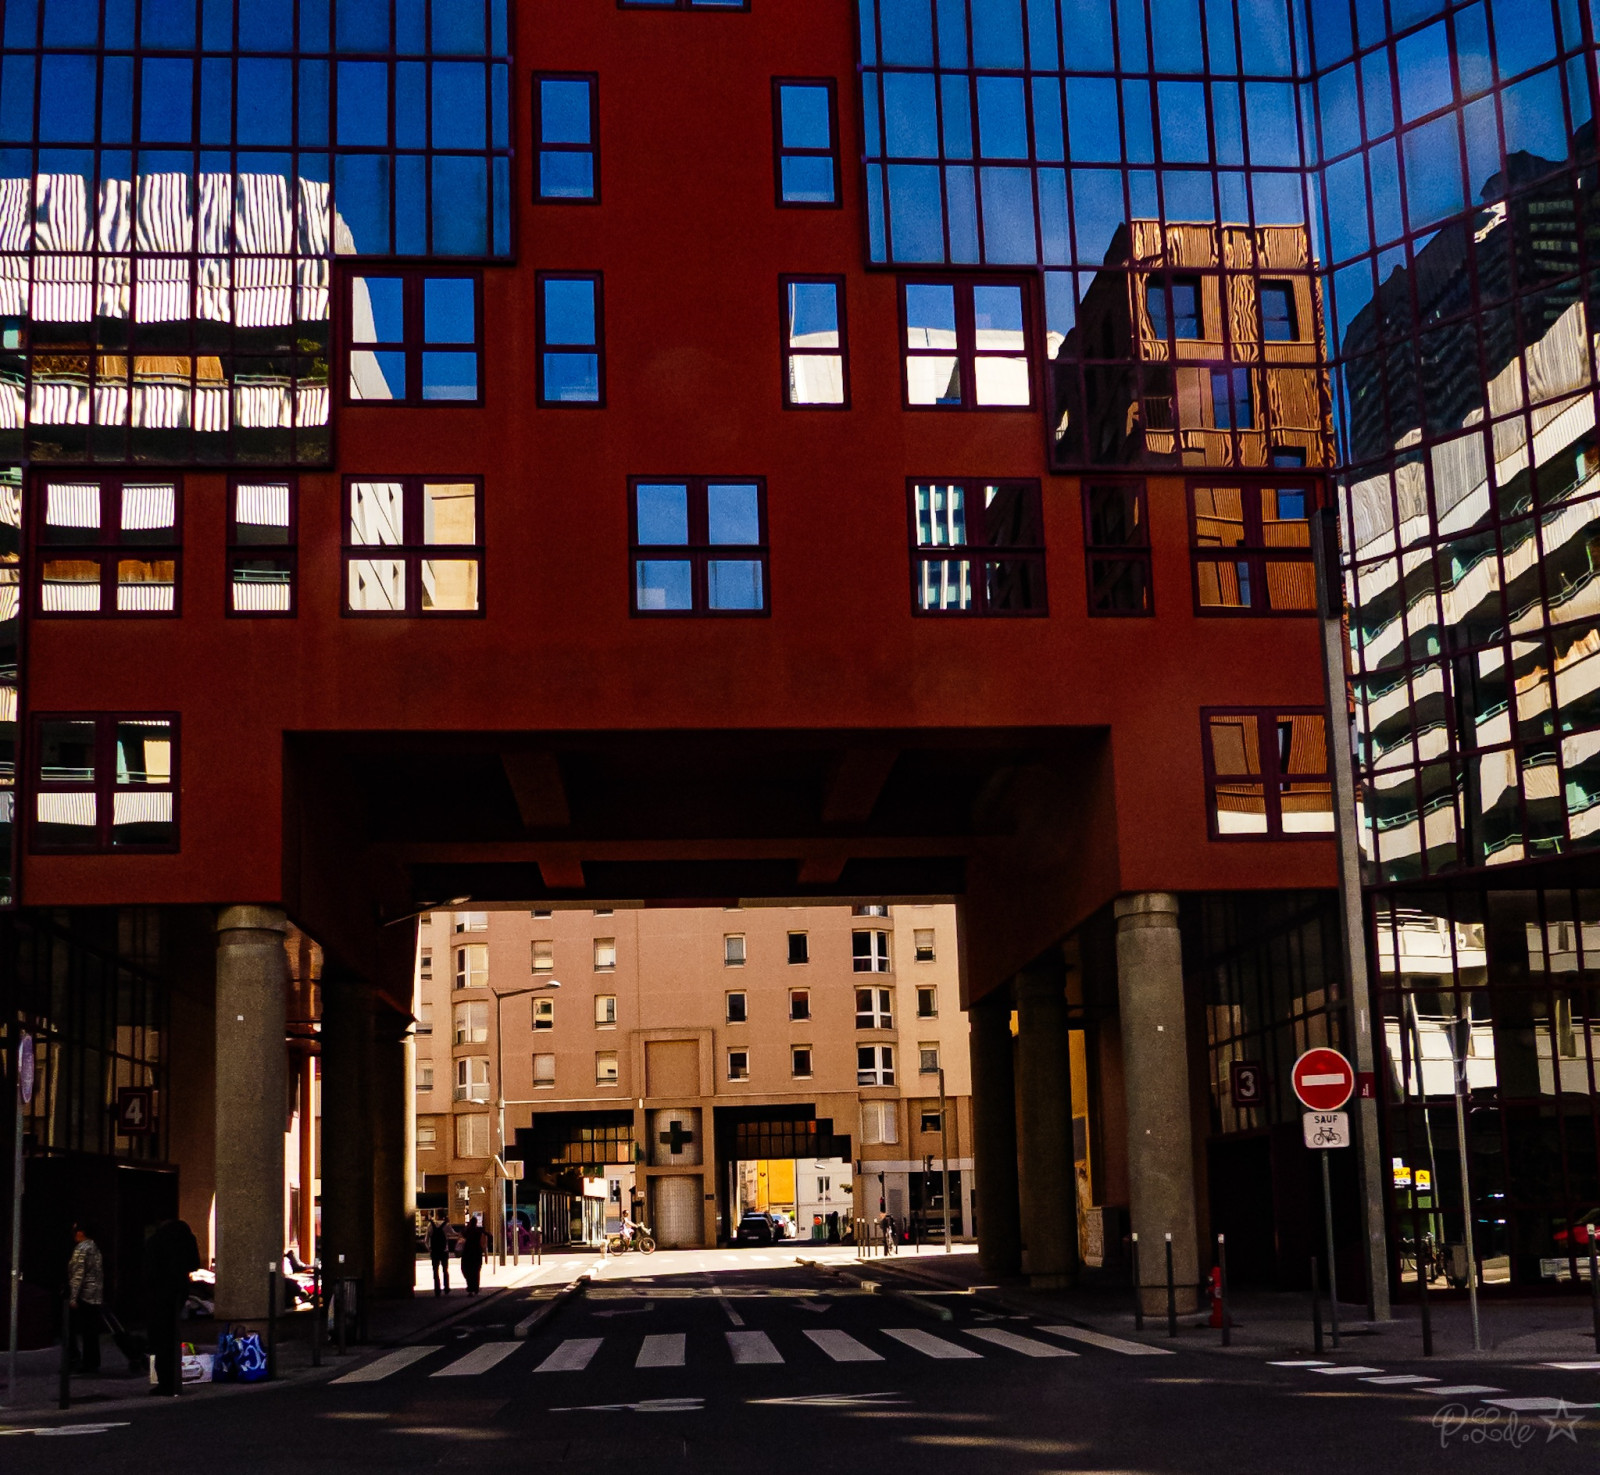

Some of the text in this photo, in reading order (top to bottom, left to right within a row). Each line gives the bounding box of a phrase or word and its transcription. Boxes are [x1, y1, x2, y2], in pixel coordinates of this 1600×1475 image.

[1240, 1070, 1256, 1097] 3
[124, 1096, 144, 1125] 4
[1314, 1114, 1339, 1124] SAUF
